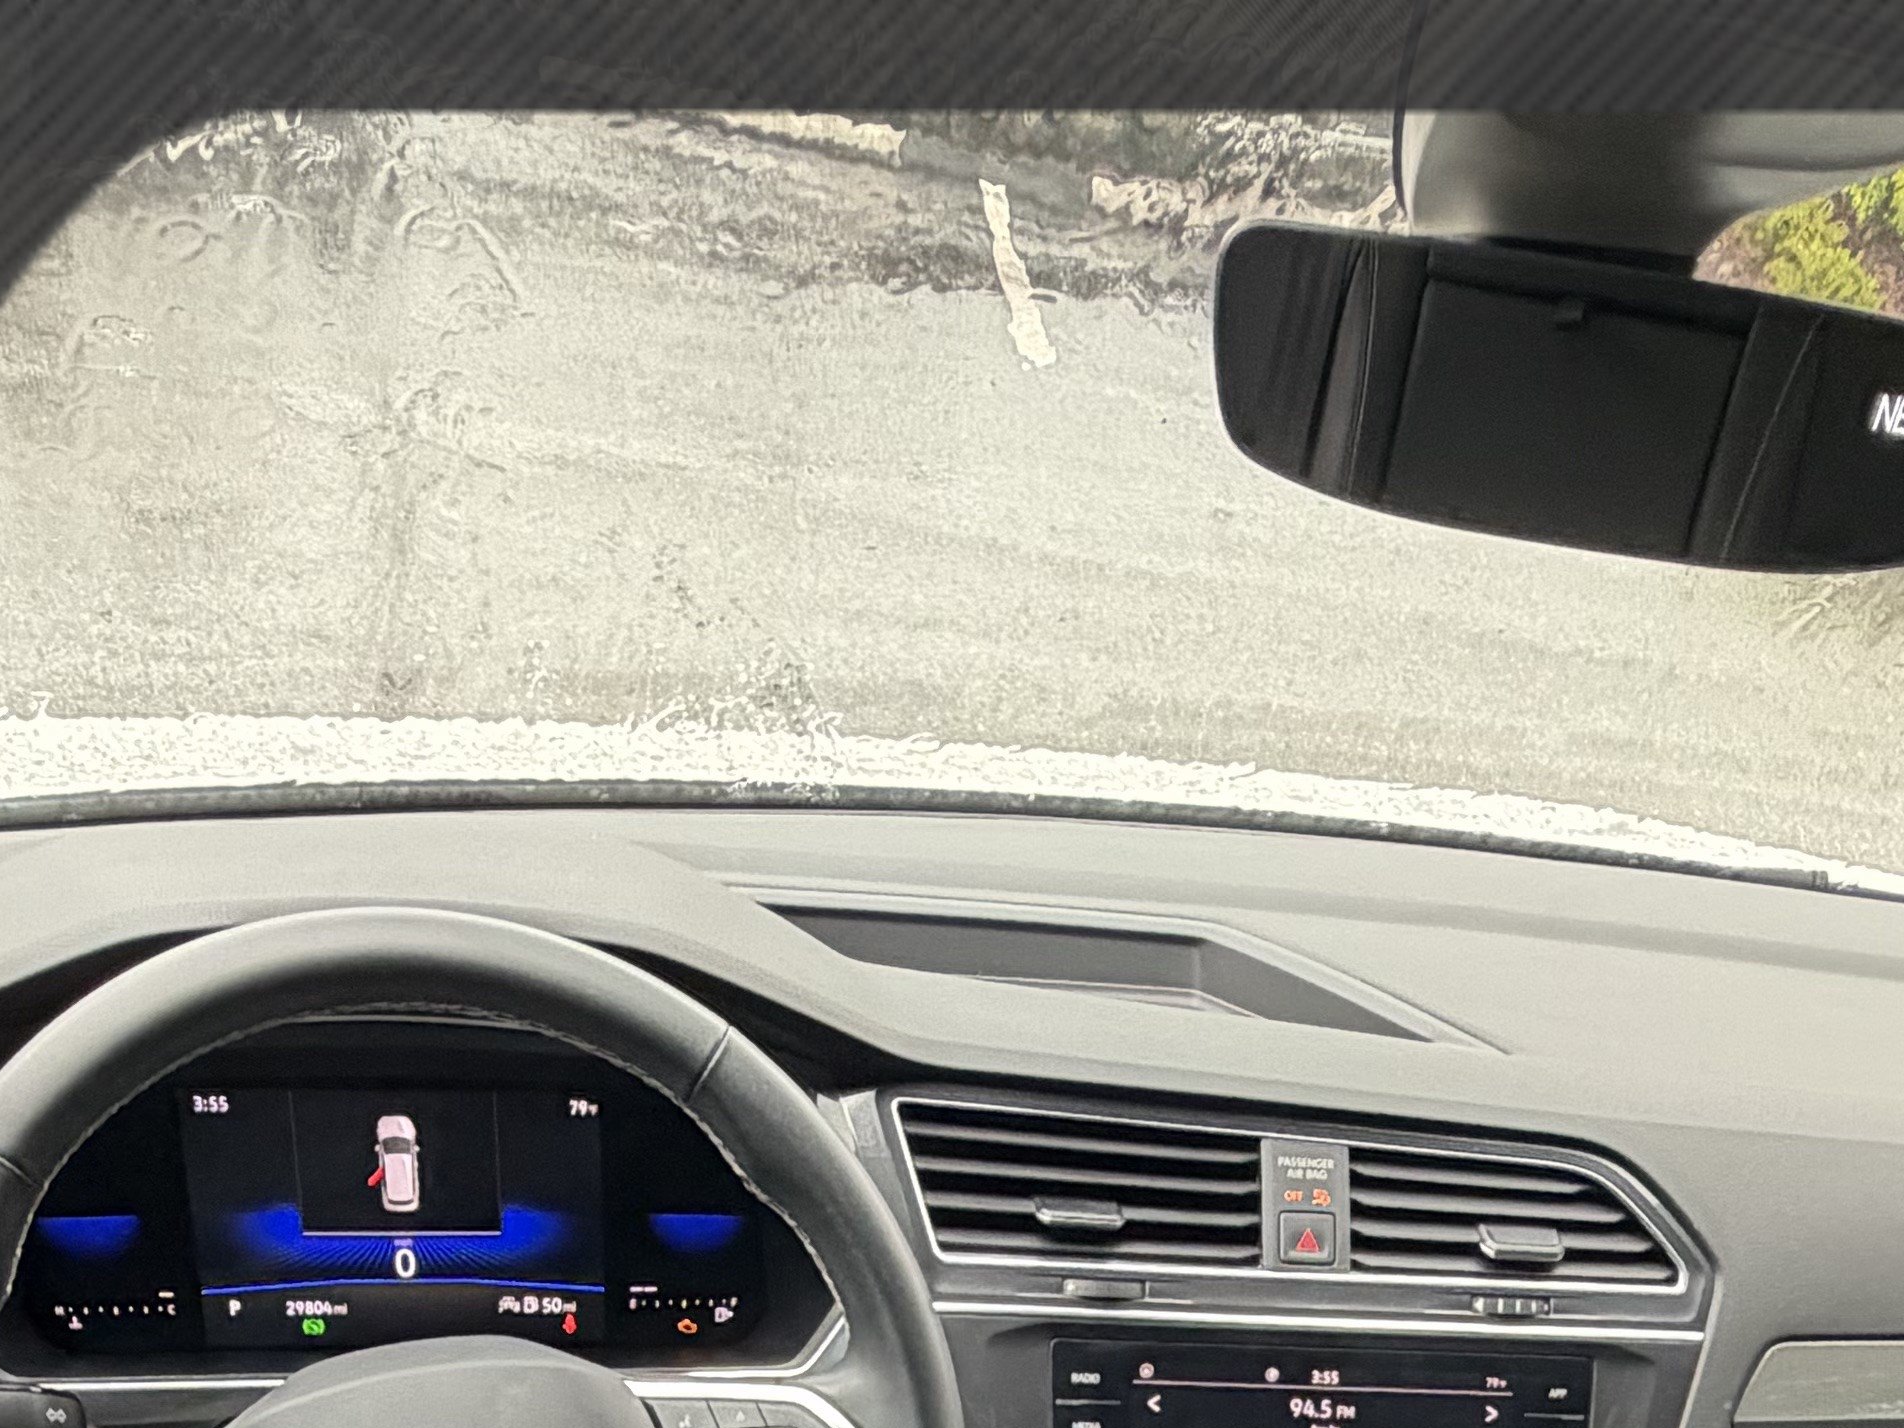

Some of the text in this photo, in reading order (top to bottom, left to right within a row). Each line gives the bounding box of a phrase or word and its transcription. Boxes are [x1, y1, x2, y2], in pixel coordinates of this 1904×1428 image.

[193, 1096, 229, 1113] 3:55
[1277, 1156, 1334, 1169] PASSENGER
[1286, 1168, 1328, 1180] AIR BAG
[1283, 1190, 1303, 1202] OFF
[395, 1248, 416, 1279] 0
[229, 1300, 241, 1316] P
[1070, 1372, 1101, 1385] RADIO
[1311, 1370, 1340, 1385] 3:55
[1289, 1398, 1356, 1420] 94.5 FM
